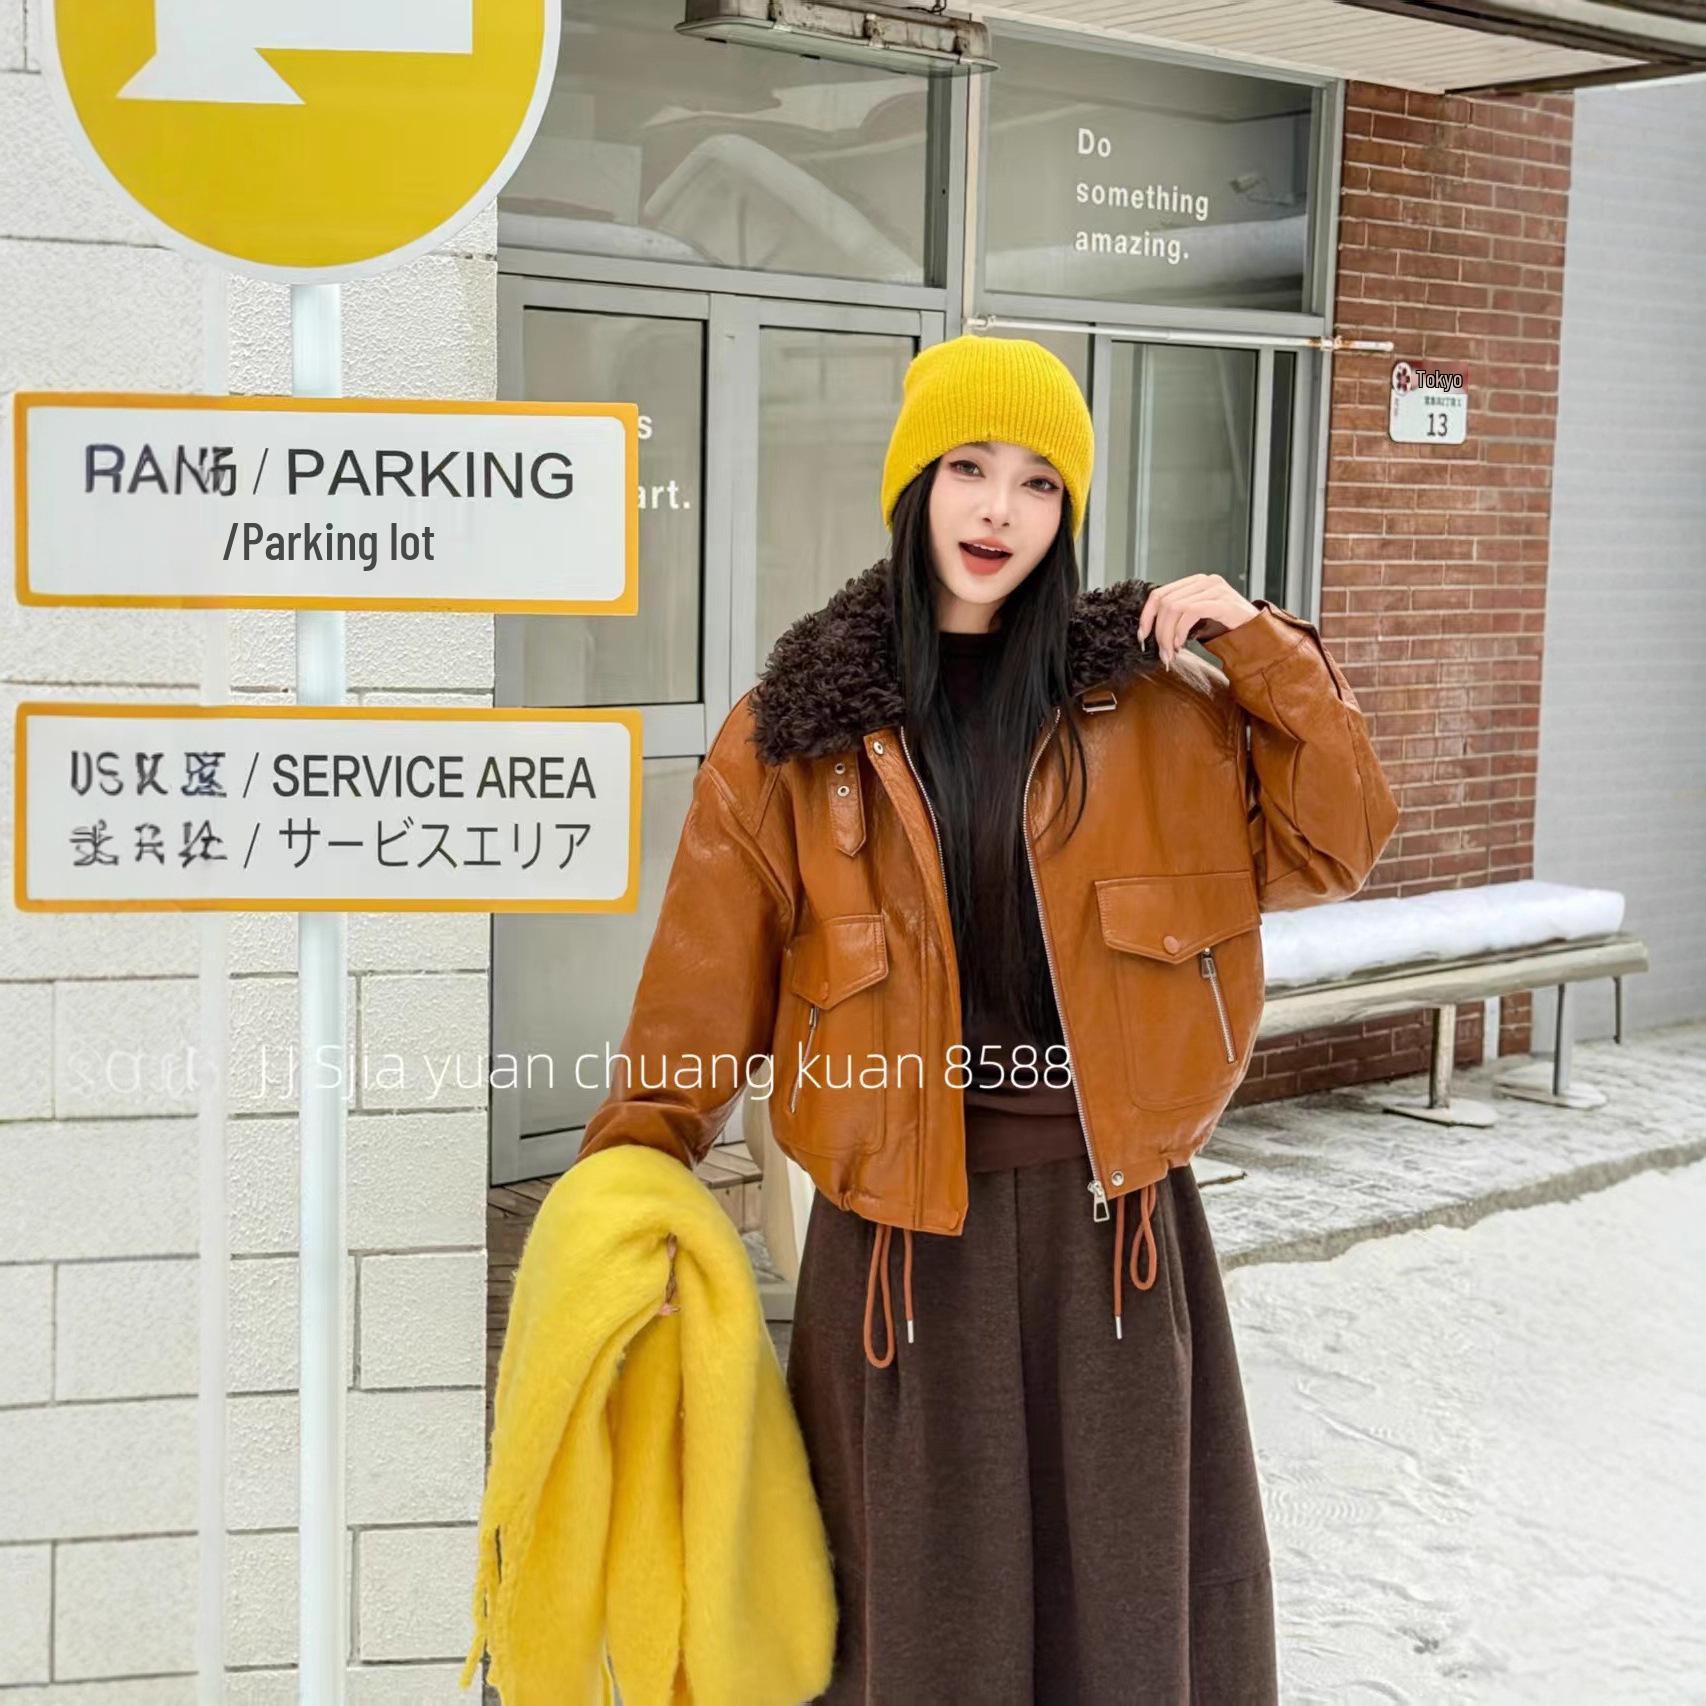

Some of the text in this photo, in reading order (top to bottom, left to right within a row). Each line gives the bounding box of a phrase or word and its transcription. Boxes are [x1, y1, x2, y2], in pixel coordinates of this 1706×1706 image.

[1078, 128, 1111, 158] Do
[1076, 182, 1209, 221] something
[1075, 231, 1189, 265] amazing.
[1427, 413, 1448, 437] 13
[287, 448, 574, 500] PARKING
[390, 522, 435, 561] lot
[272, 753, 465, 799] SERVICE
[476, 756, 597, 799] AREA
[278, 815, 591, 870] サービスエリア
